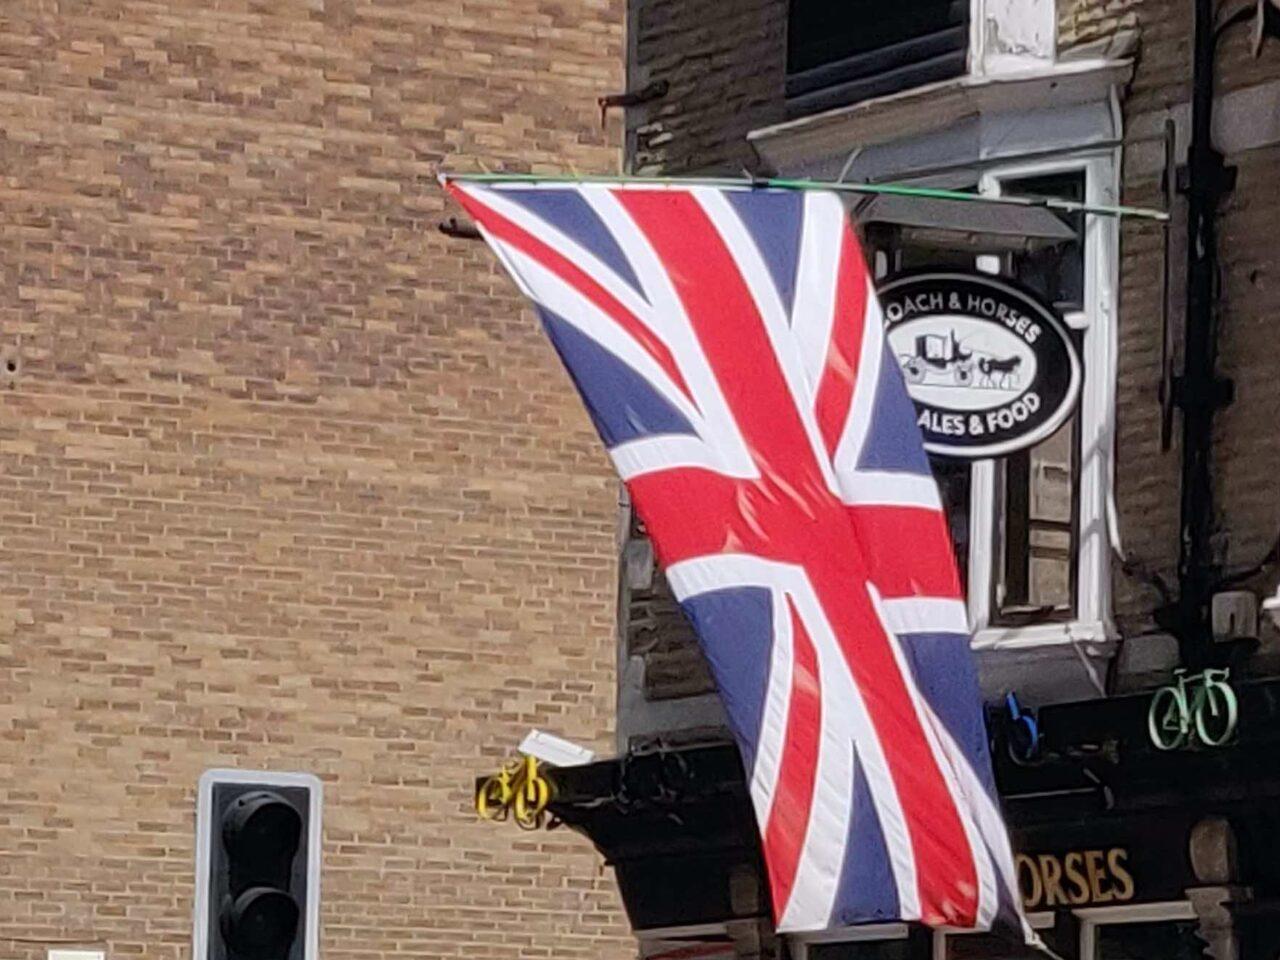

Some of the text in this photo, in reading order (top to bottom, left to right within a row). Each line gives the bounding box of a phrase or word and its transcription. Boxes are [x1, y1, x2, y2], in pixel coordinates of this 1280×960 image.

[884, 292, 1043, 344] OACH & HORSES
[917, 392, 1041, 436] ALES & FOOD
[1015, 848, 1135, 906] ORSES
